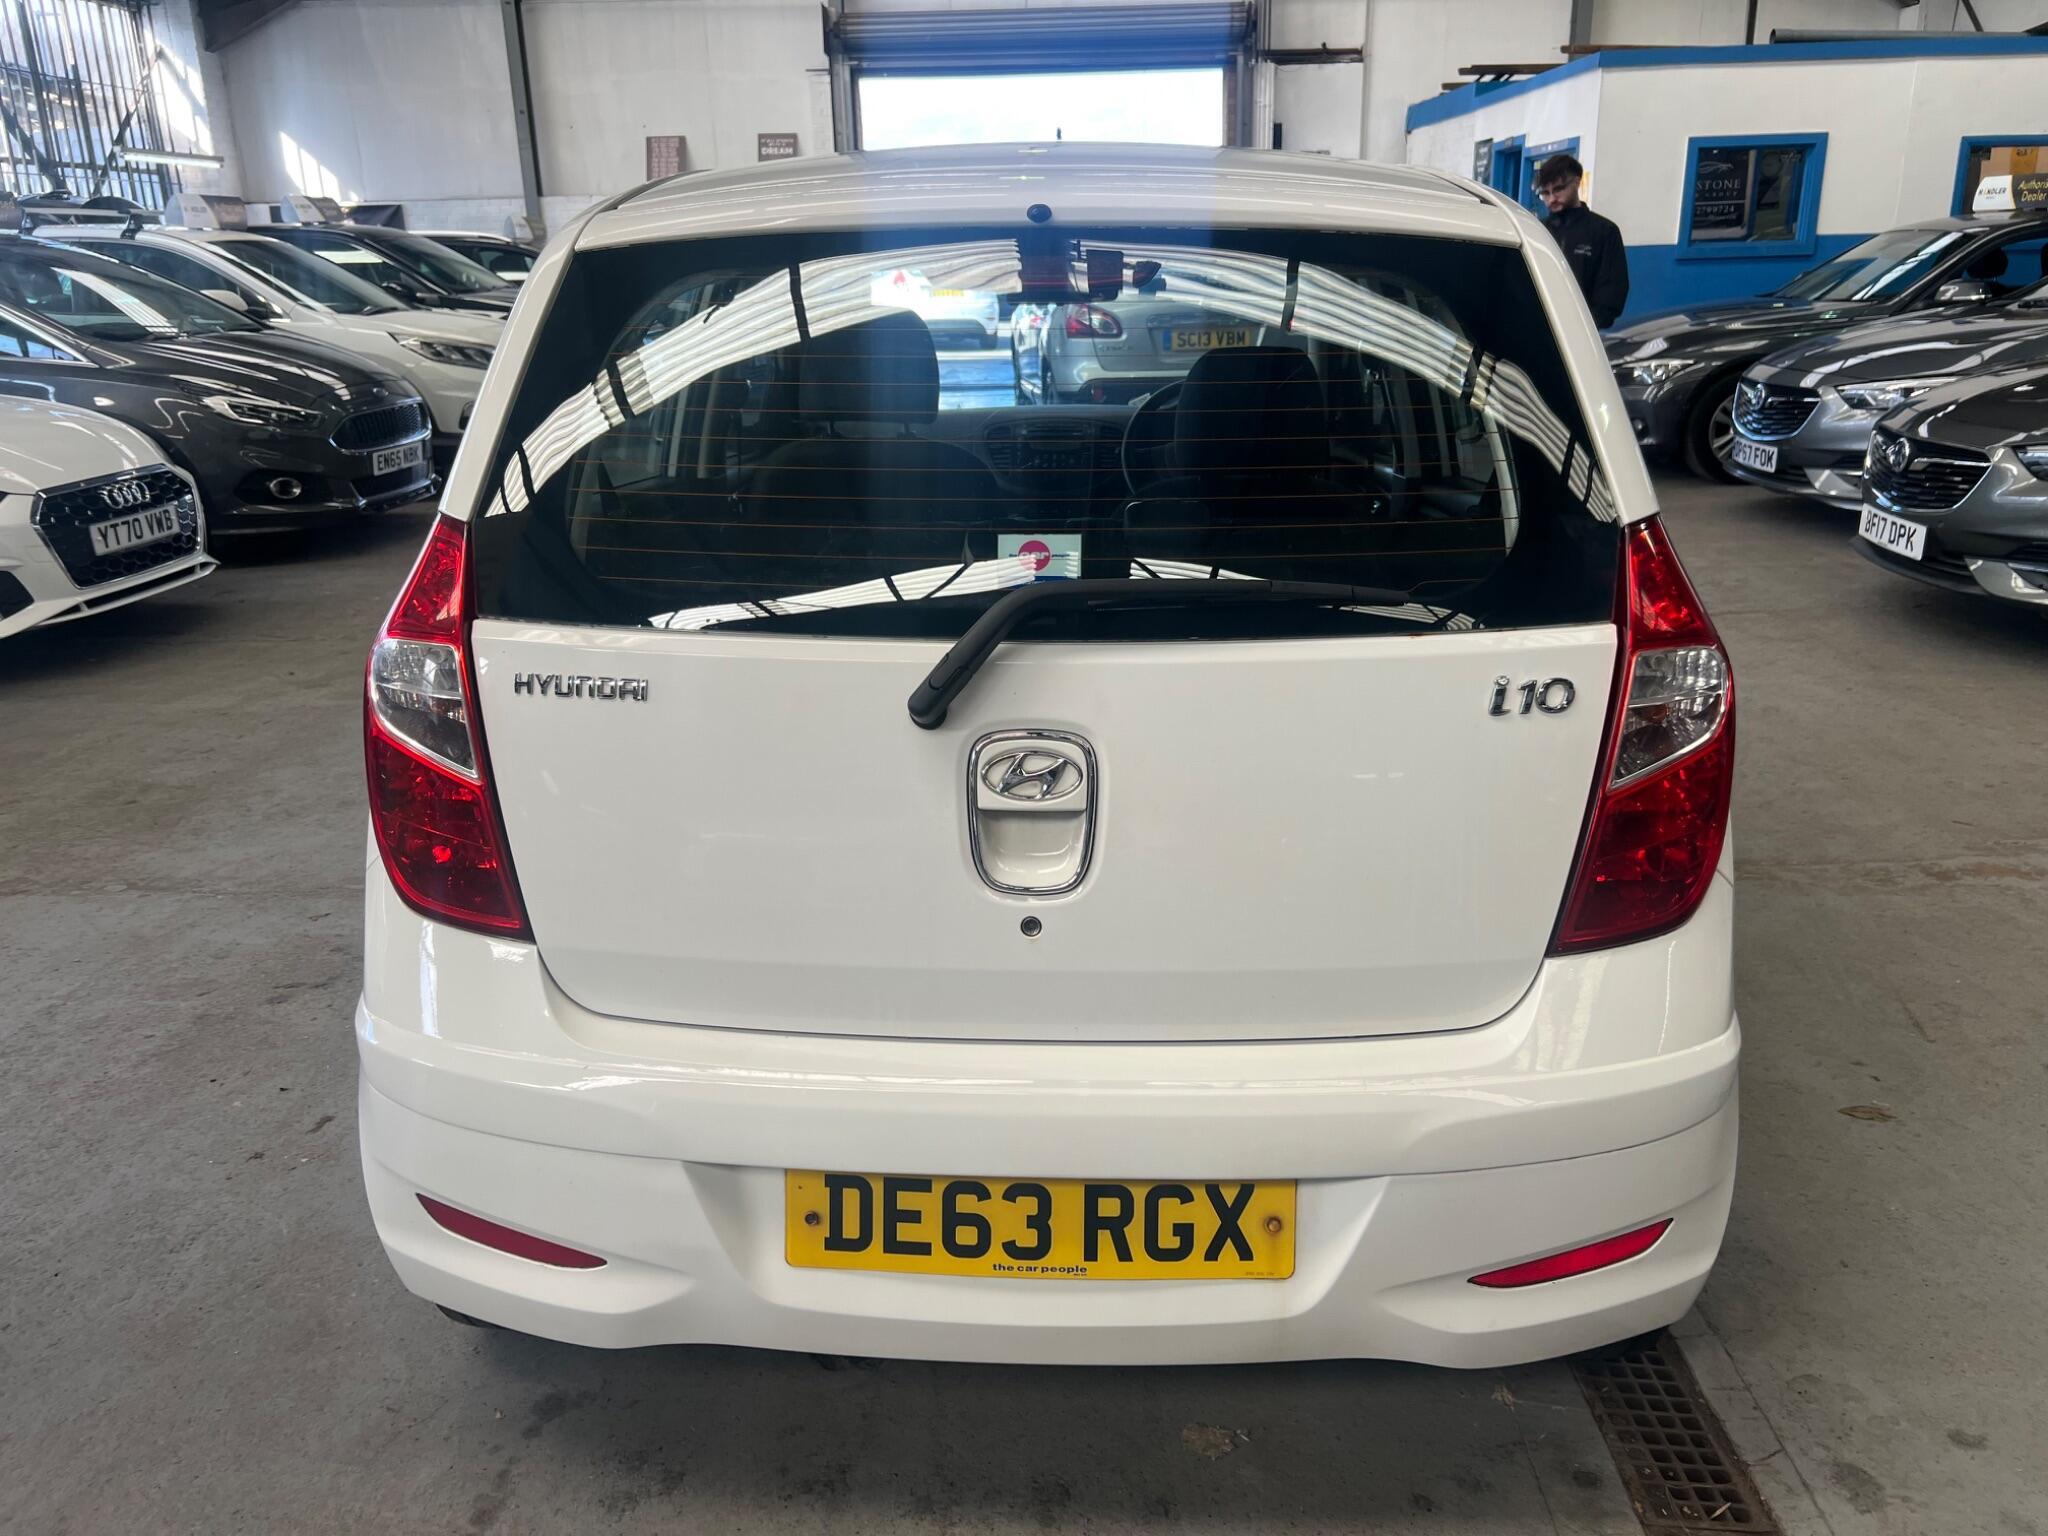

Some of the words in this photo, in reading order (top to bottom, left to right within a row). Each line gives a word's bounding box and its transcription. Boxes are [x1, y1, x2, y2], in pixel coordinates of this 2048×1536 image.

[2021, 190, 2047, 202] Dealer
[1177, 331, 1212, 348] SC13
[1215, 330, 1246, 346] VBM
[377, 450, 402, 471] EN65
[1753, 447, 1774, 469] FOK
[97, 517, 143, 549] YT70
[145, 509, 173, 536] VWB
[1888, 520, 1917, 552] DPK
[514, 672, 648, 702] HYUNDAI
[1488, 675, 1576, 717] i10
[824, 1173, 1053, 1262] DE63
[1083, 1182, 1256, 1263] RGX
[992, 1263, 1015, 1272] the
[1040, 1264, 1088, 1274] people
